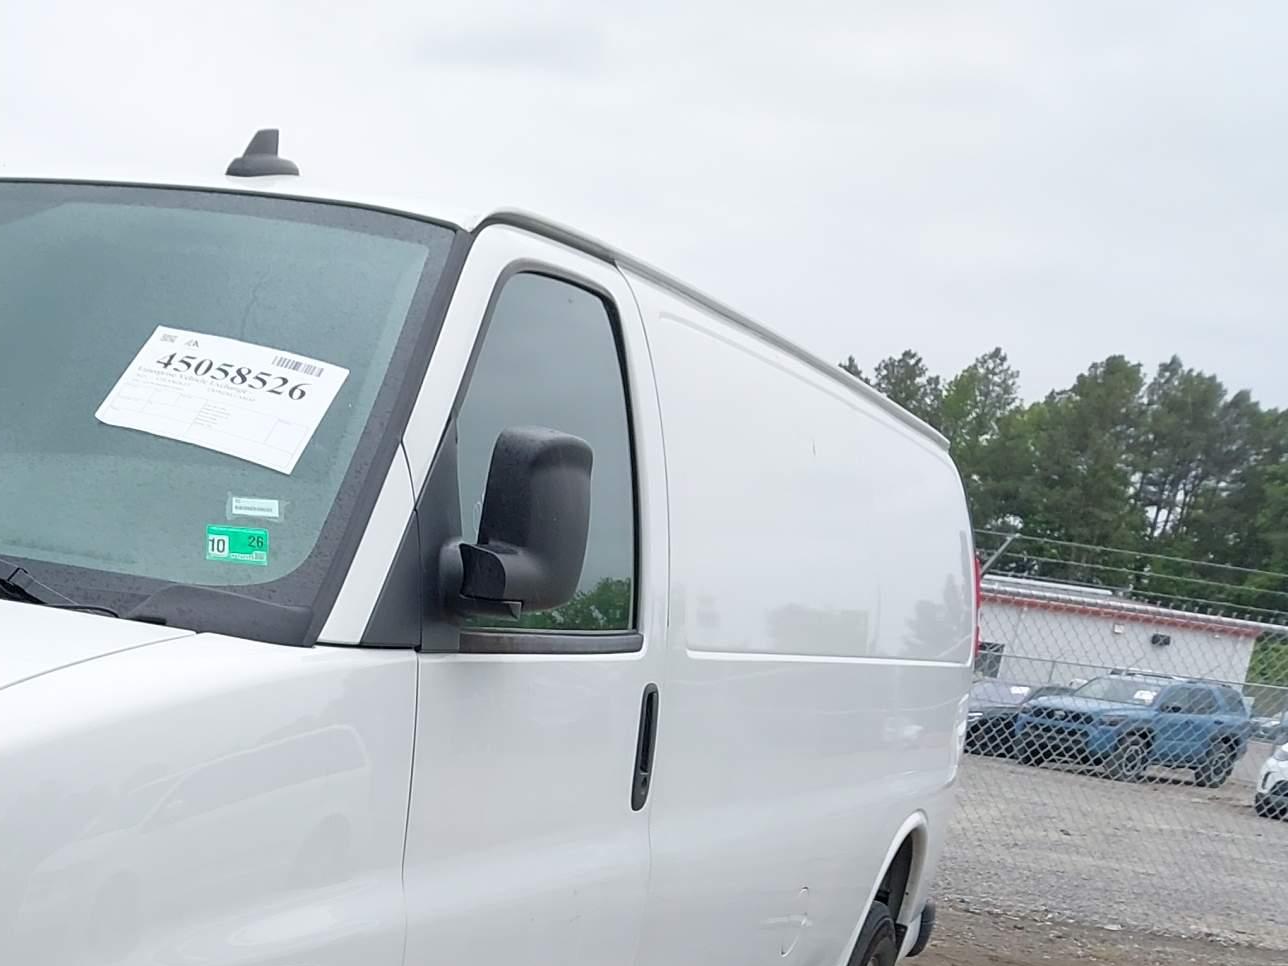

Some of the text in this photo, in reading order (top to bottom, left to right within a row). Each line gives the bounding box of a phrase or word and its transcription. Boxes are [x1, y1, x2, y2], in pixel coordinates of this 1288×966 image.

[156, 352, 313, 401] 45058526
[209, 535, 264, 553] 10 26
